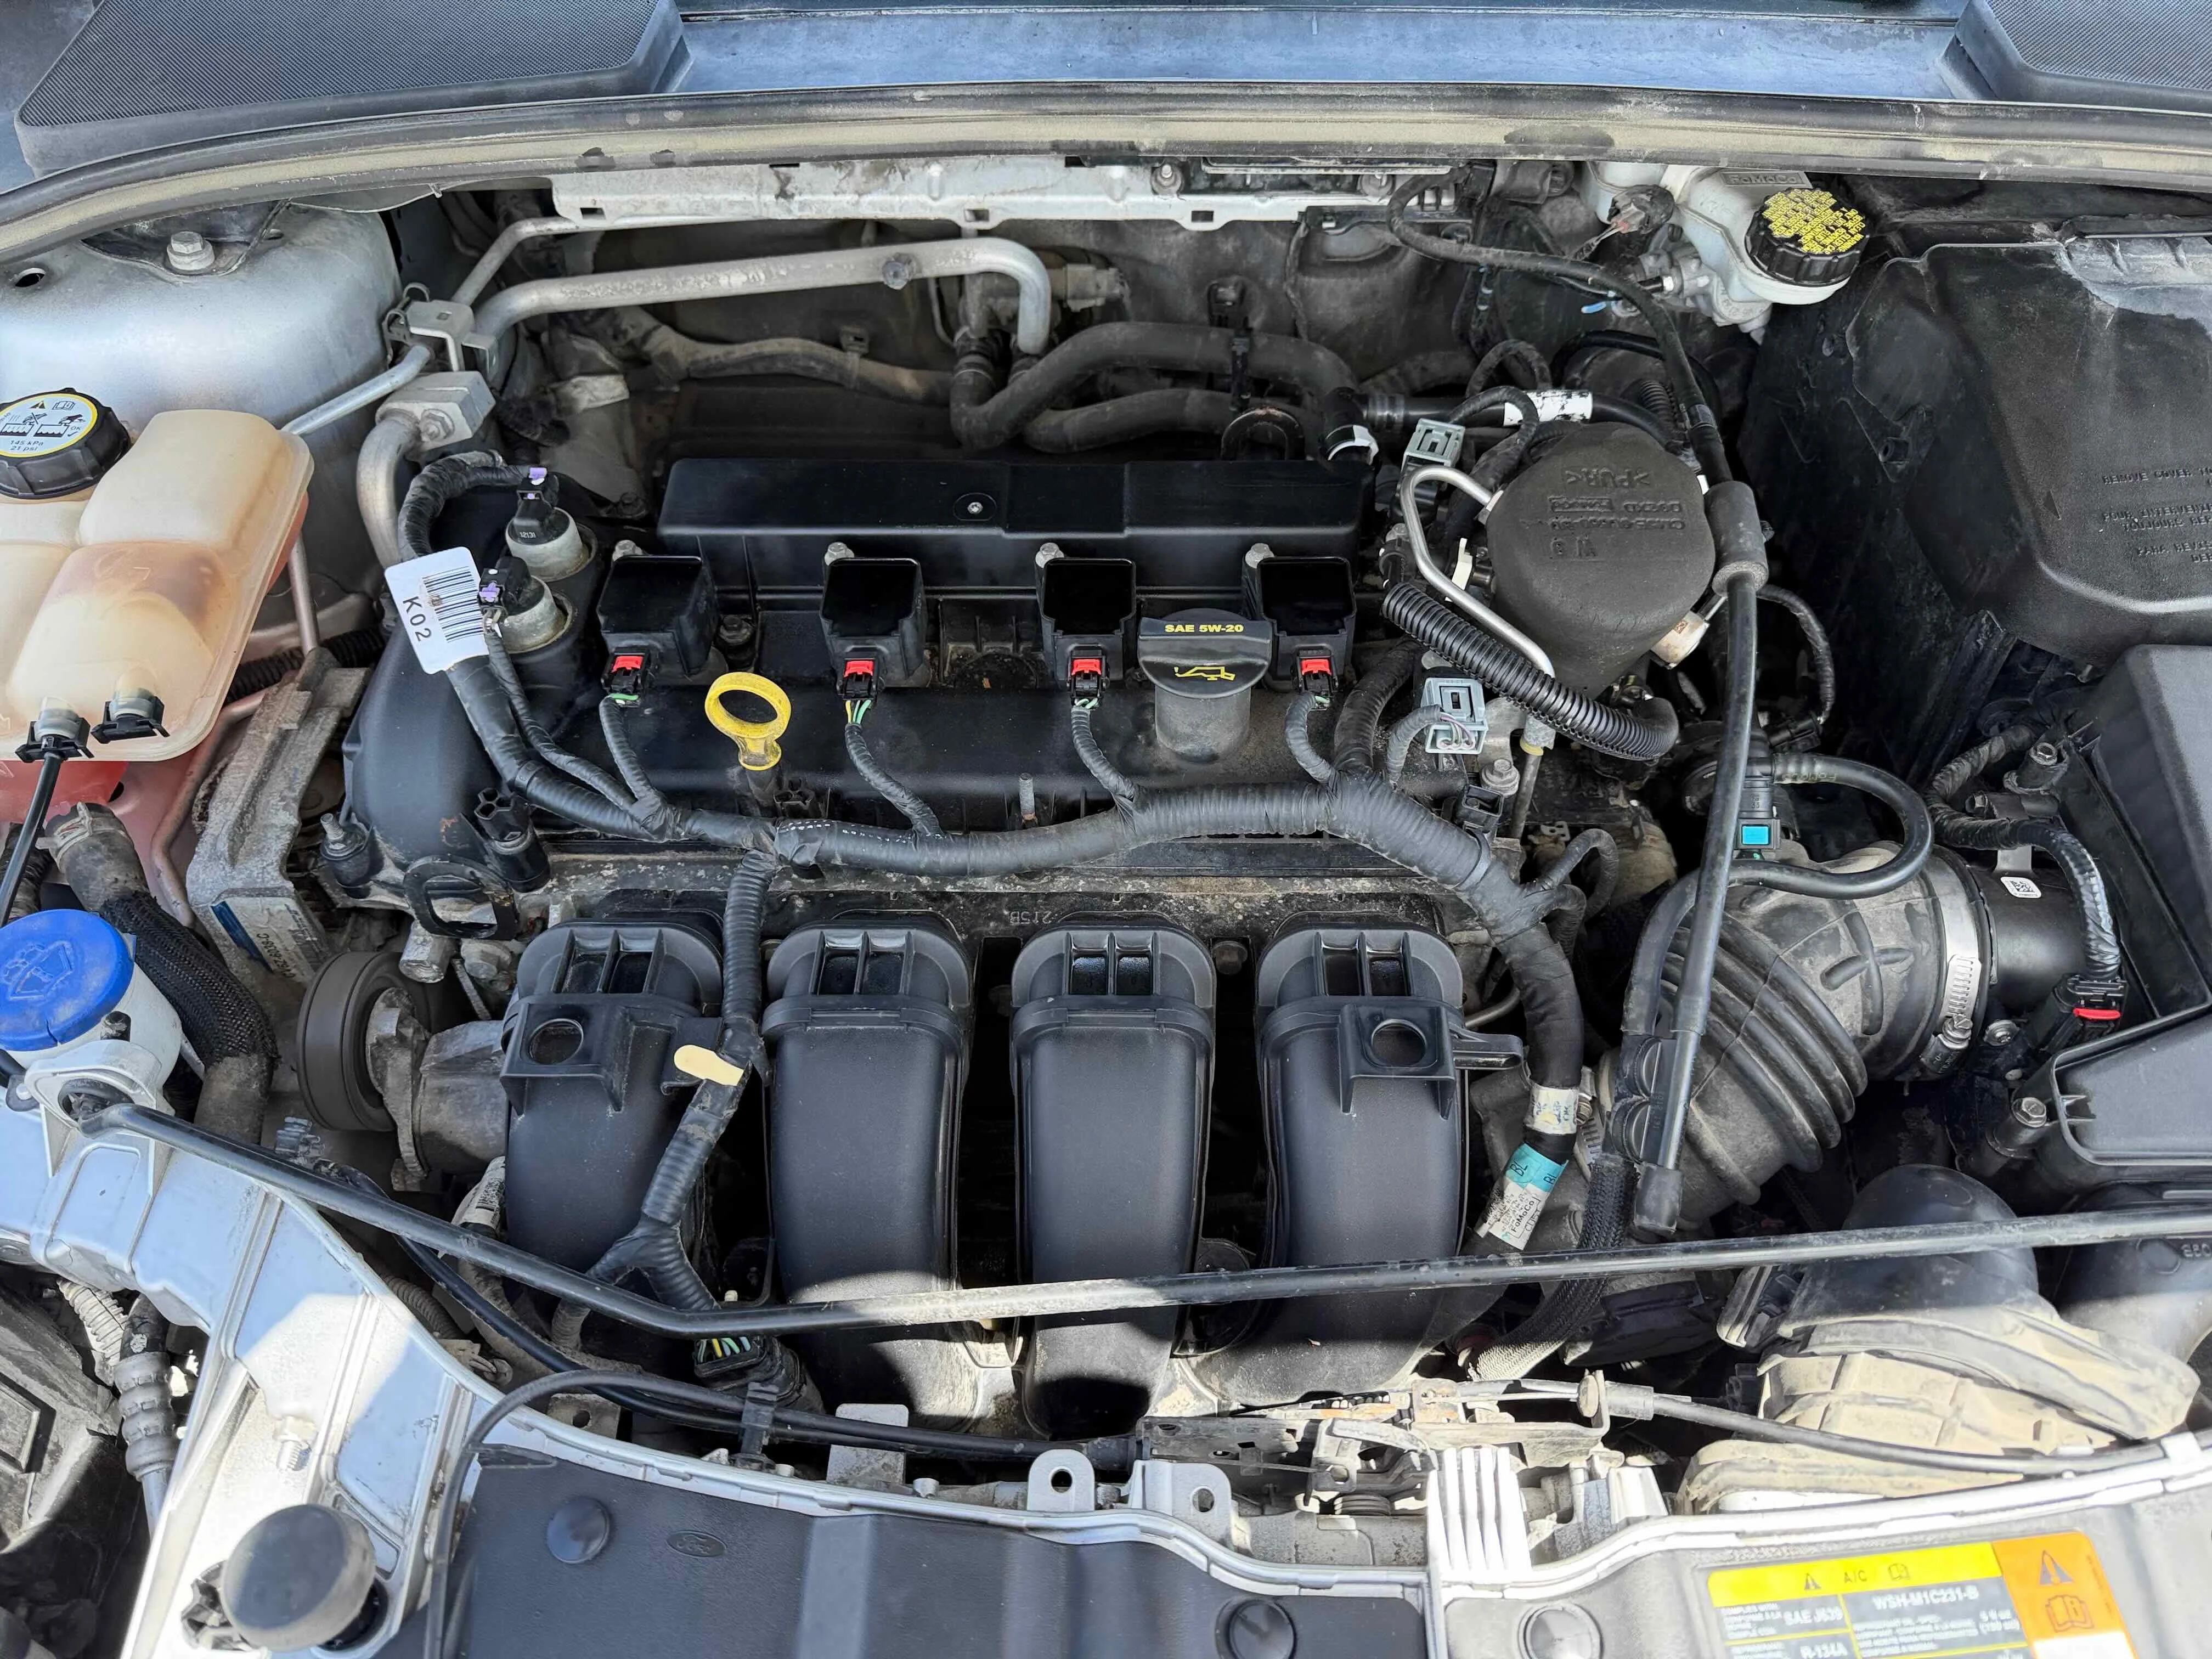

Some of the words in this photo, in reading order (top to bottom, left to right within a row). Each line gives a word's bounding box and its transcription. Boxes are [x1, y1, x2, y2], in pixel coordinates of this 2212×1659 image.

[1728, 174, 1797, 184] FoMoCo
[1822, 211, 1843, 225] SEALED
[1843, 209, 1858, 218] ONLY
[1832, 218, 1846, 227] DOT
[1843, 215, 1863, 228] BEFORE
[1848, 222, 1865, 234] CLEAN
[1814, 229, 1831, 240] FLUID
[1832, 233, 1850, 246] FILLER
[402, 596, 432, 642] K02
[1165, 624, 1195, 633] SAE
[1199, 624, 1244, 633] 5W-20
[1509, 1160, 1528, 1177] BL
[1511, 1200, 1535, 1233] FoMoCo
[1844, 1570, 1867, 1584] A/C
[1872, 1585, 1979, 1610] WSH-M1C231-B
[1783, 1608, 1813, 1626] SAE
